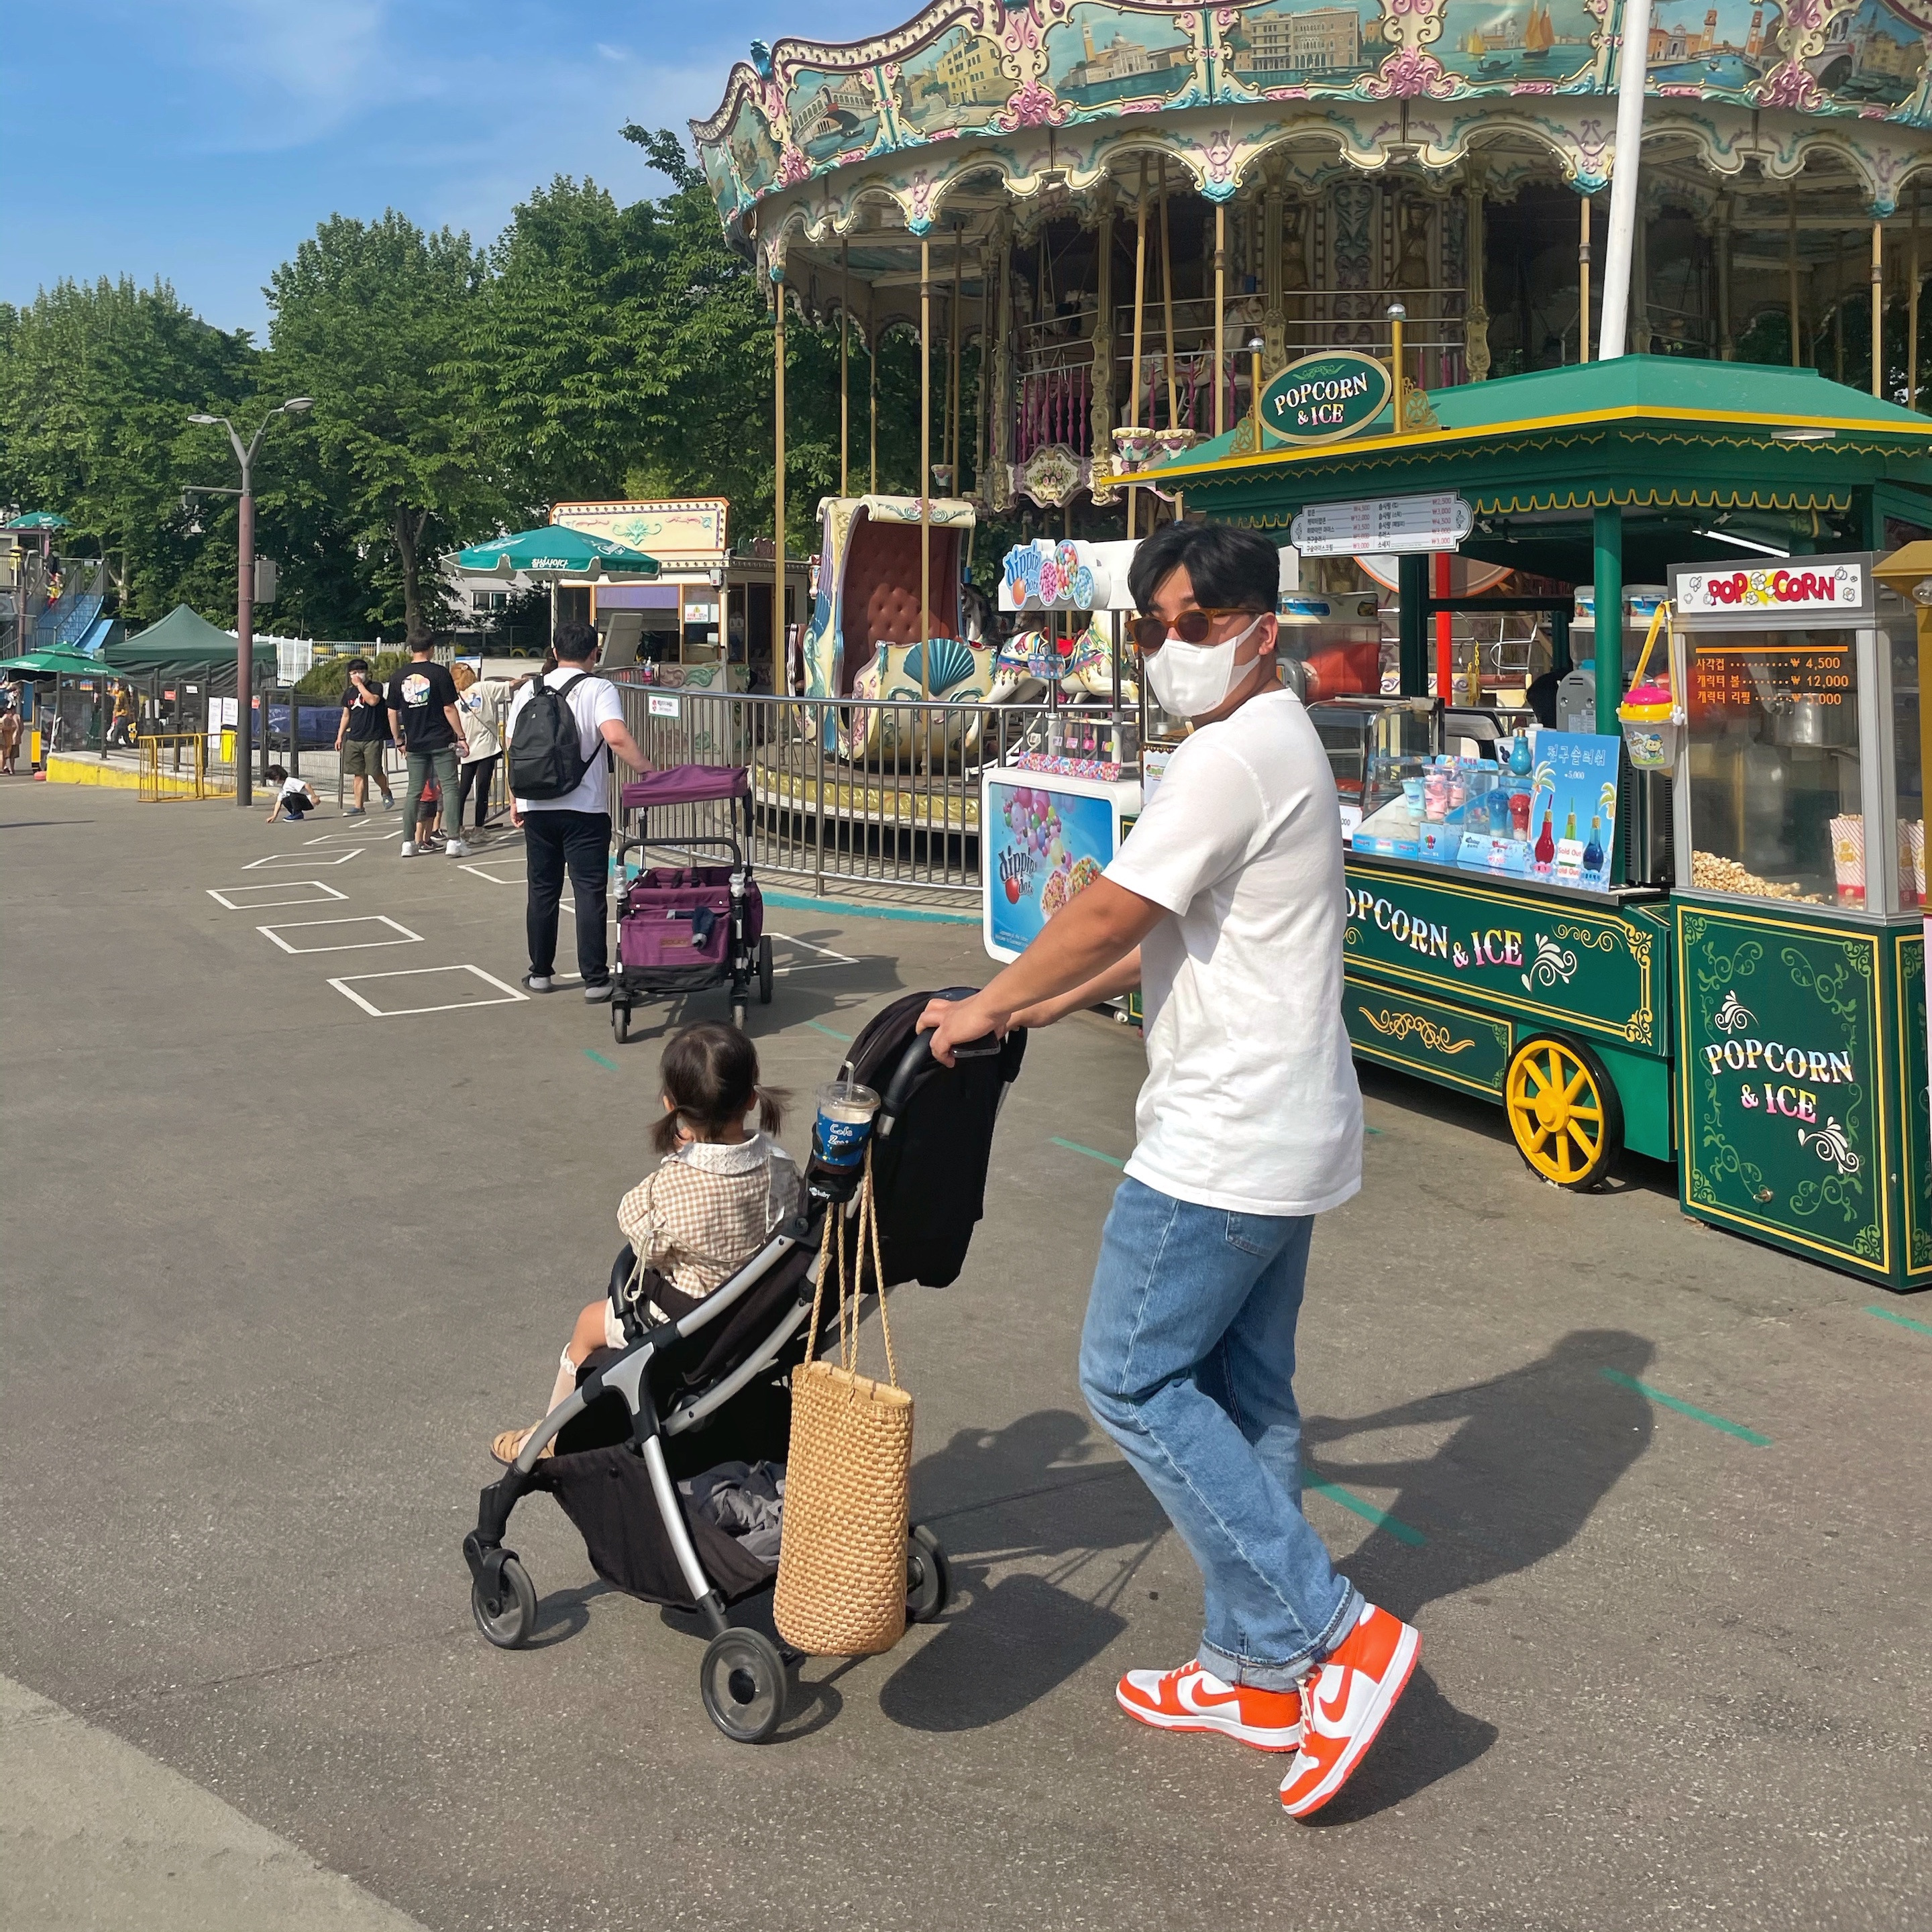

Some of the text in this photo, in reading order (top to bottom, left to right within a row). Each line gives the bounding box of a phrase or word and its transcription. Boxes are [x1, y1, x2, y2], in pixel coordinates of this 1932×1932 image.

[1274, 372, 1368, 416] POPCORN
[1297, 403, 1344, 426] & ICE
[531, 556, 569, 569] 칠성사이다
[1708, 570, 1835, 606] POP CORN
[1696, 657, 1725, 671] 사각컵
[1805, 657, 1841, 671] 4,500
[1697, 675, 1725, 688] 캐릭터
[1730, 675, 1740, 688] 볼
[1807, 675, 1849, 689] 12,000
[1697, 691, 1725, 704] 캐릭터
[1731, 691, 1751, 705] 리필
[1547, 743, 1607, 767] 전구슬러쉬
[1572, 849, 1582, 857] Out
[1345, 886, 1522, 968] OPCORN & ICE
[1705, 1038, 1854, 1083] POPCORN
[1741, 1083, 1817, 1124] & ICE
